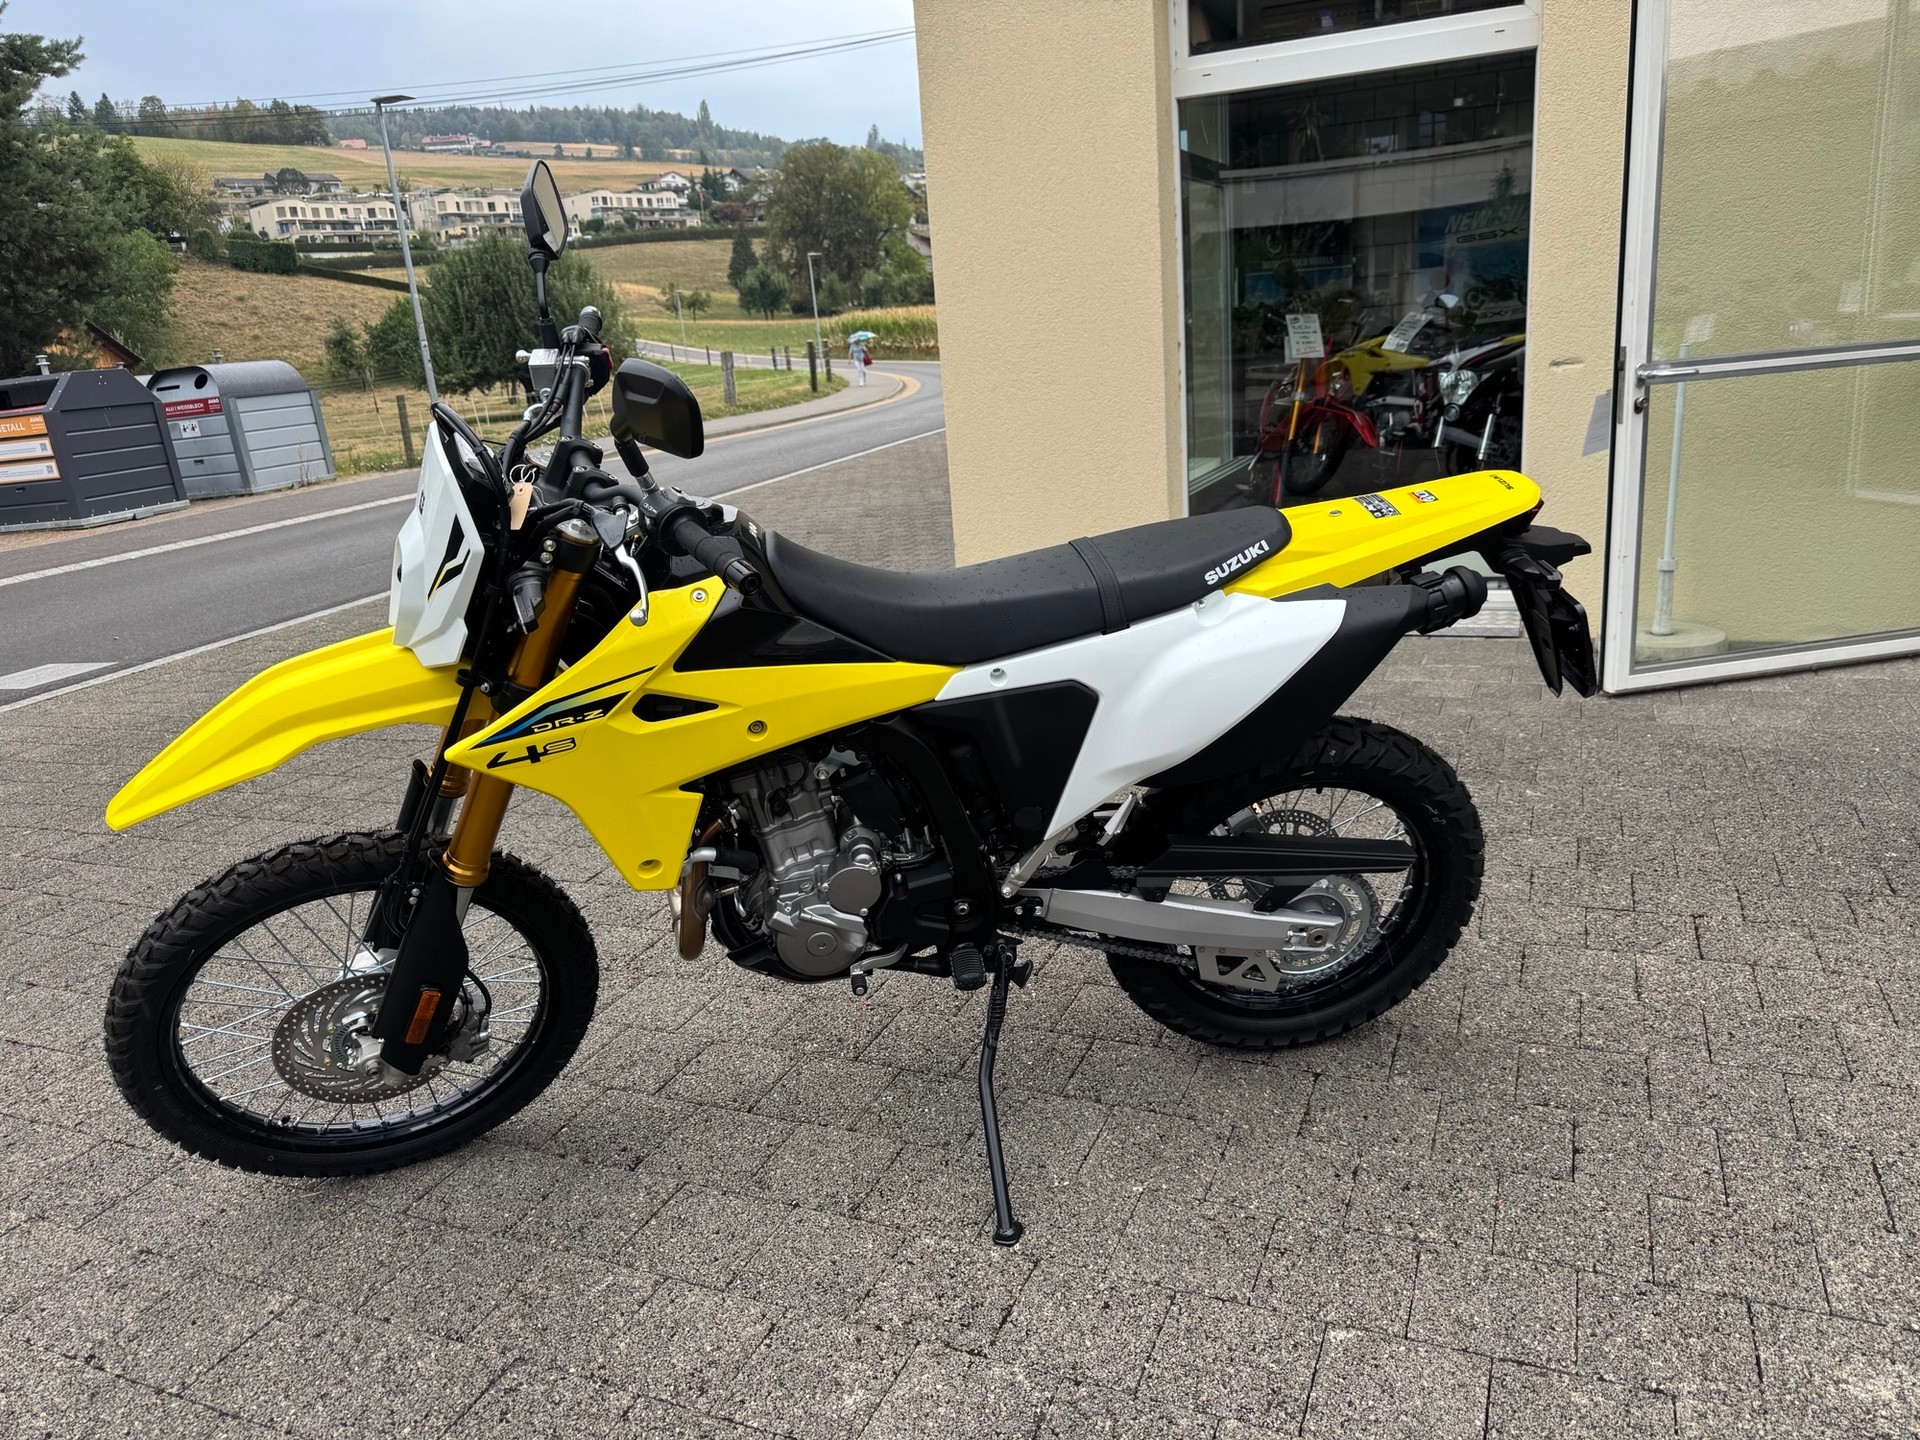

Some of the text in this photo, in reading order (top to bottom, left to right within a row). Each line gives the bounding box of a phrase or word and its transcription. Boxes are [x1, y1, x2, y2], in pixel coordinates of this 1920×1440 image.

[1444, 208, 1492, 234] NEW
[1204, 539, 1270, 585] SUZUKI
[531, 709, 604, 733] DR-Z
